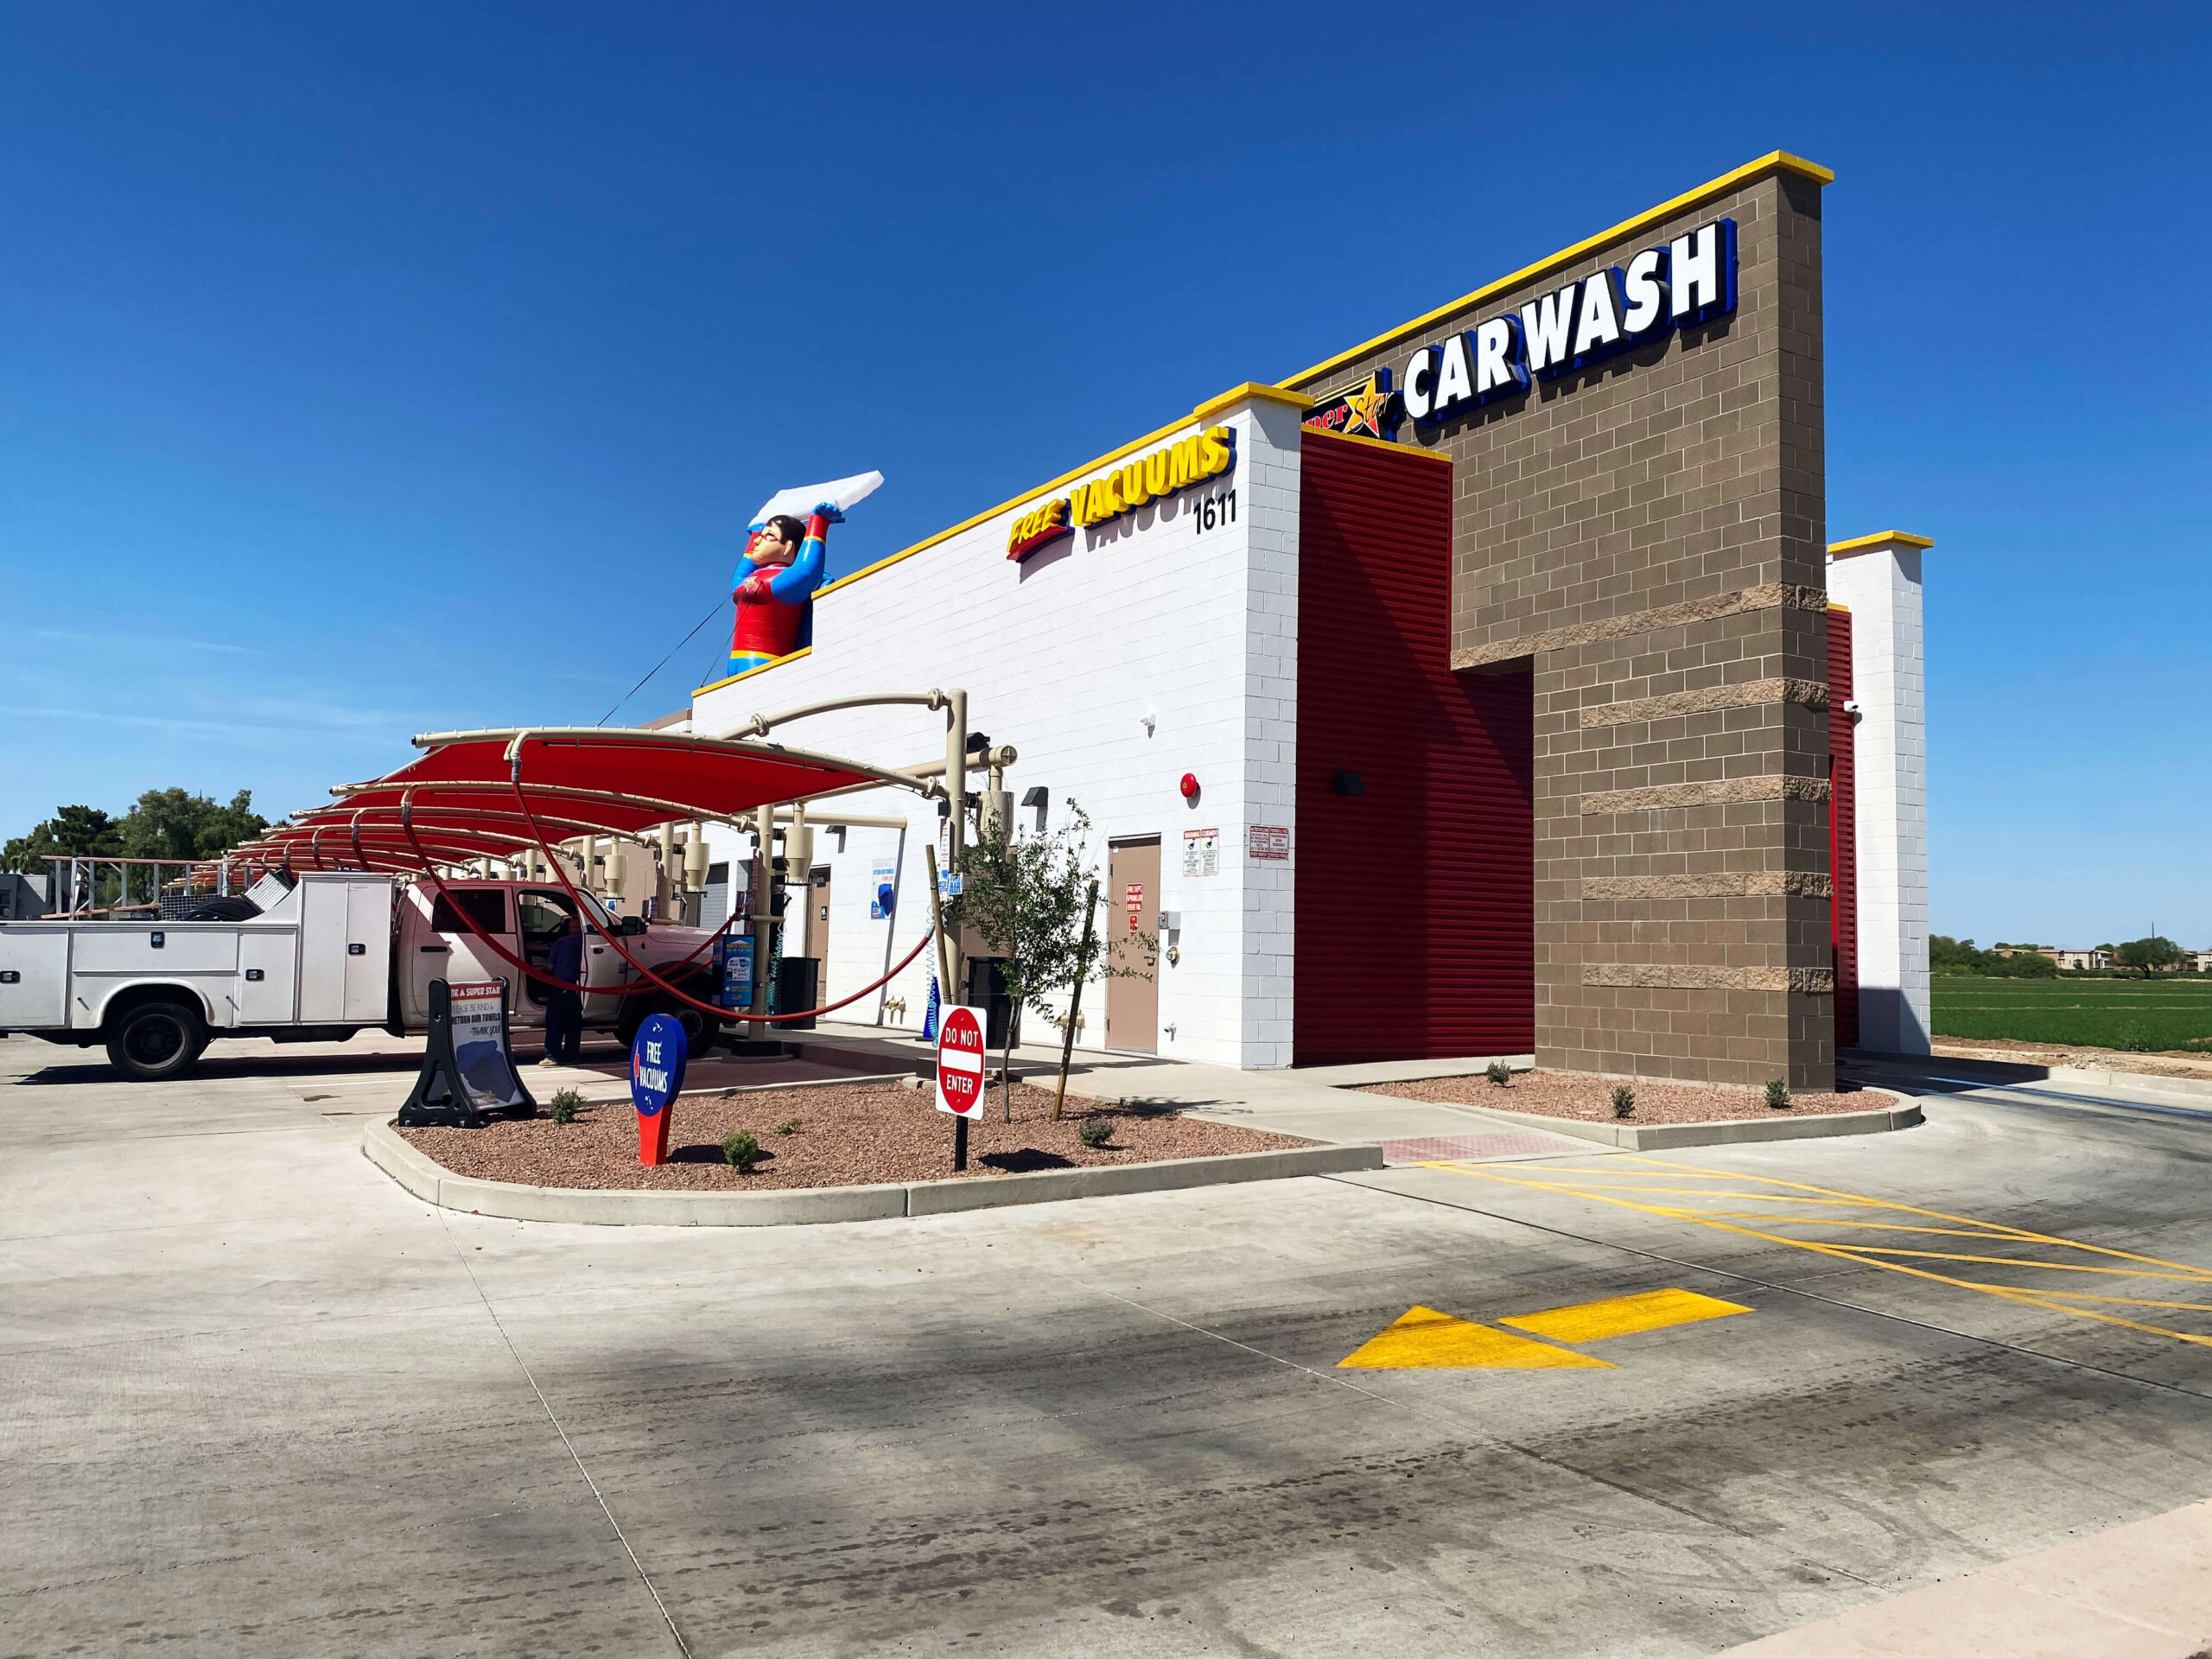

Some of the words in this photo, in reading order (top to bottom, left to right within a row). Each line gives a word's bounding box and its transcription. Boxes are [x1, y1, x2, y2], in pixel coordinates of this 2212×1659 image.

[1403, 317, 1512, 419] CAR
[1520, 221, 1719, 373] WASH
[1350, 391, 1395, 433] Star
[1006, 498, 1067, 553] FREE
[1070, 425, 1230, 528] VACUUMS
[1192, 488, 1237, 535] 1611
[460, 988, 466, 997] A
[466, 987, 485, 996] SUPER
[486, 986, 501, 995] STAR
[452, 1015, 471, 1025] RETURN
[471, 1014, 482, 1023] OUR
[482, 1013, 501, 1022] TOWELS
[477, 1002, 489, 1012] KIND
[945, 1027, 957, 1044] DO
[960, 1029, 978, 1047] NOT
[646, 1040, 662, 1065] FREE
[639, 1065, 669, 1094] VACUUMS
[946, 1074, 973, 1095] ENTER
